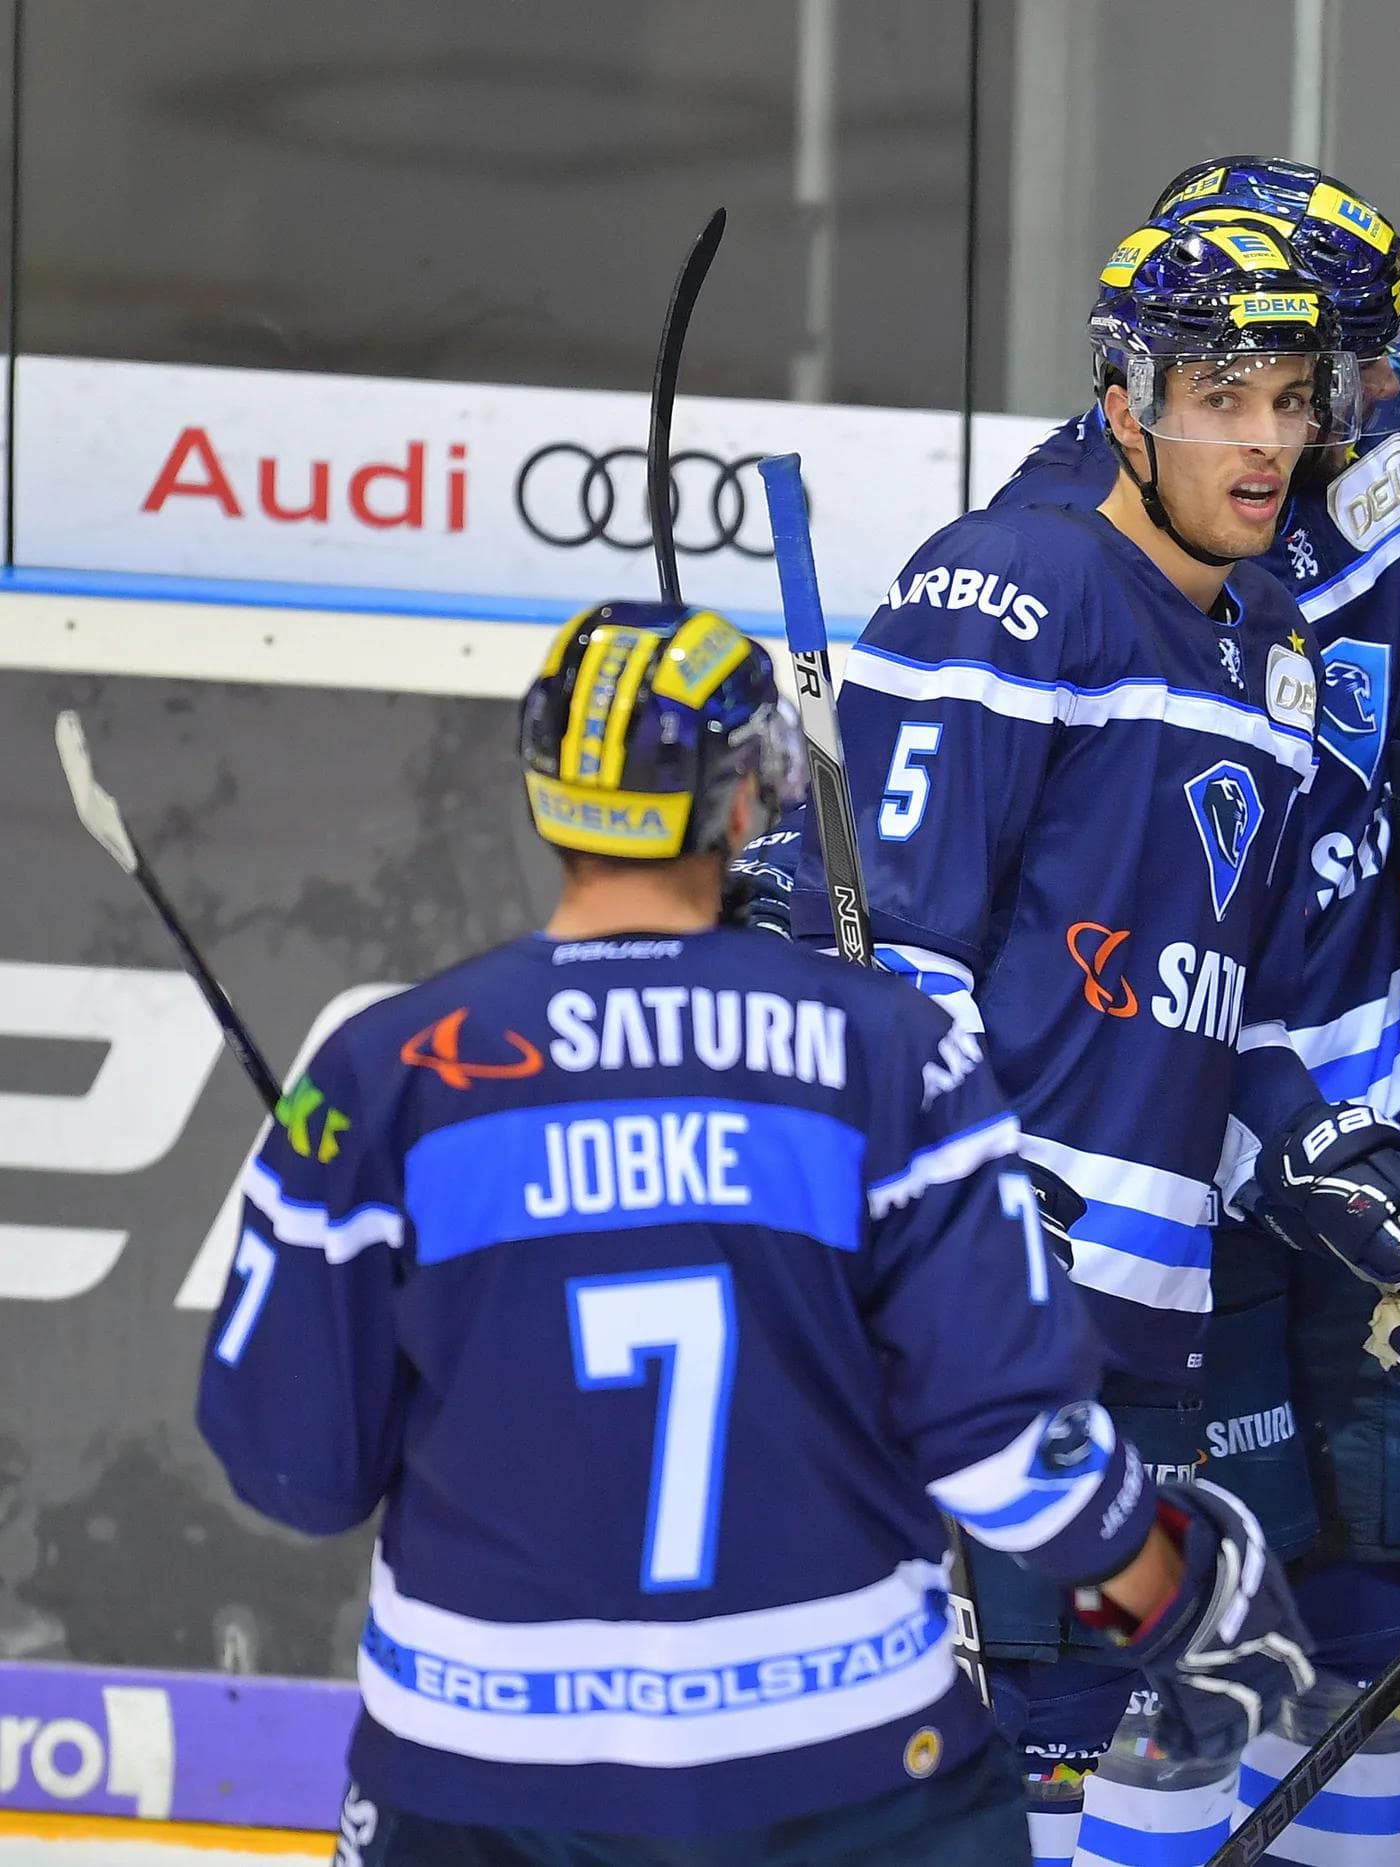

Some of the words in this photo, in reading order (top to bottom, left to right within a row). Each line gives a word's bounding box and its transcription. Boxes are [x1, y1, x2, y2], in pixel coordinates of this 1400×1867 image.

[1244, 299, 1310, 313] EDEKA
[141, 426, 469, 533] Audi
[536, 791, 669, 838] EDEKA
[876, 720, 944, 842] 5
[552, 938, 684, 966] BAUER
[546, 985, 848, 1091] SATURN
[524, 1112, 751, 1219] JOBKE
[998, 1170, 1052, 1306] 7
[215, 1227, 279, 1368] 7
[565, 1263, 739, 1593] 7
[415, 1655, 529, 1711] ERC
[554, 1612, 932, 1714] INGOLSTADT
